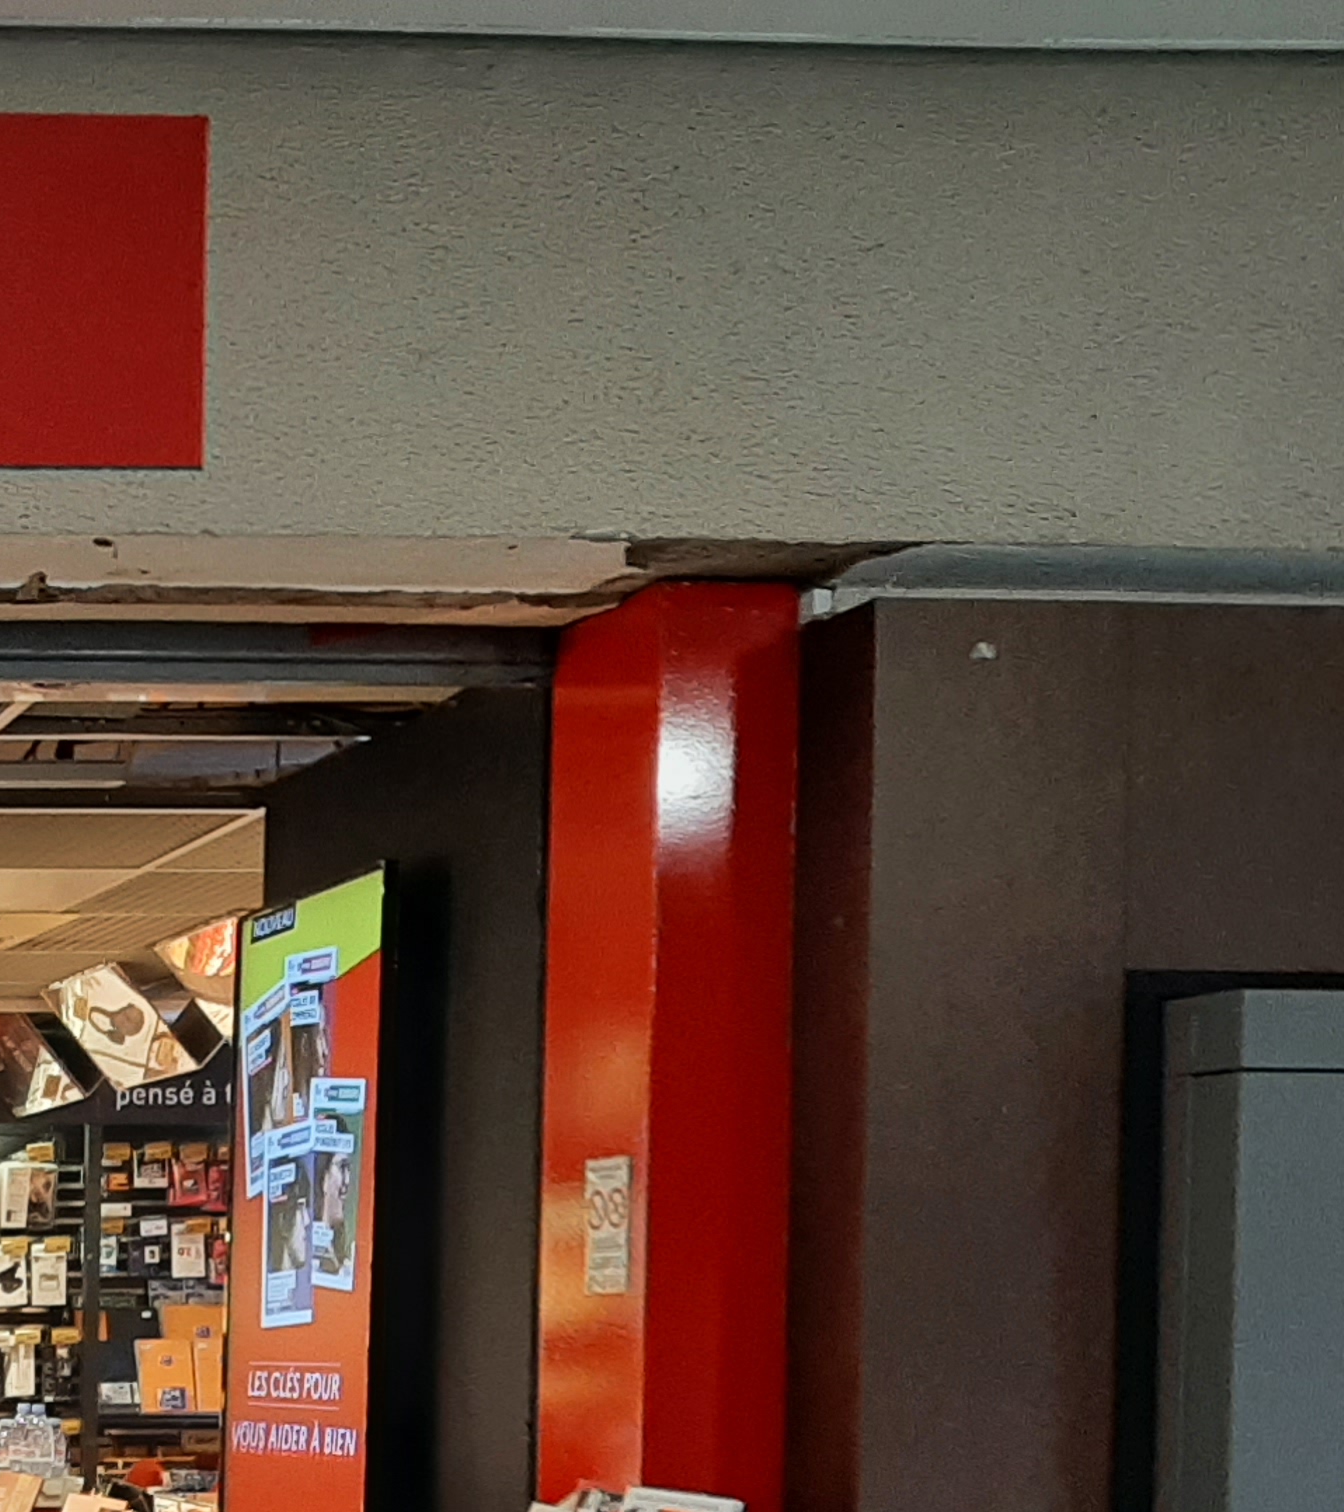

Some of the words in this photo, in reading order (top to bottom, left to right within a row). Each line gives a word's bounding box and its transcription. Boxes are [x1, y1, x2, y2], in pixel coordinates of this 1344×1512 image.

[116, 1080, 194, 1112] pensé
[202, 1080, 217, 1106] à
[248, 1370, 269, 1398] LES
[270, 1367, 301, 1400] CLÉS
[303, 1372, 341, 1402] POUR
[232, 1420, 267, 1453] VOUS
[268, 1422, 308, 1454] AIDER
[323, 1427, 358, 1457] BIEN
